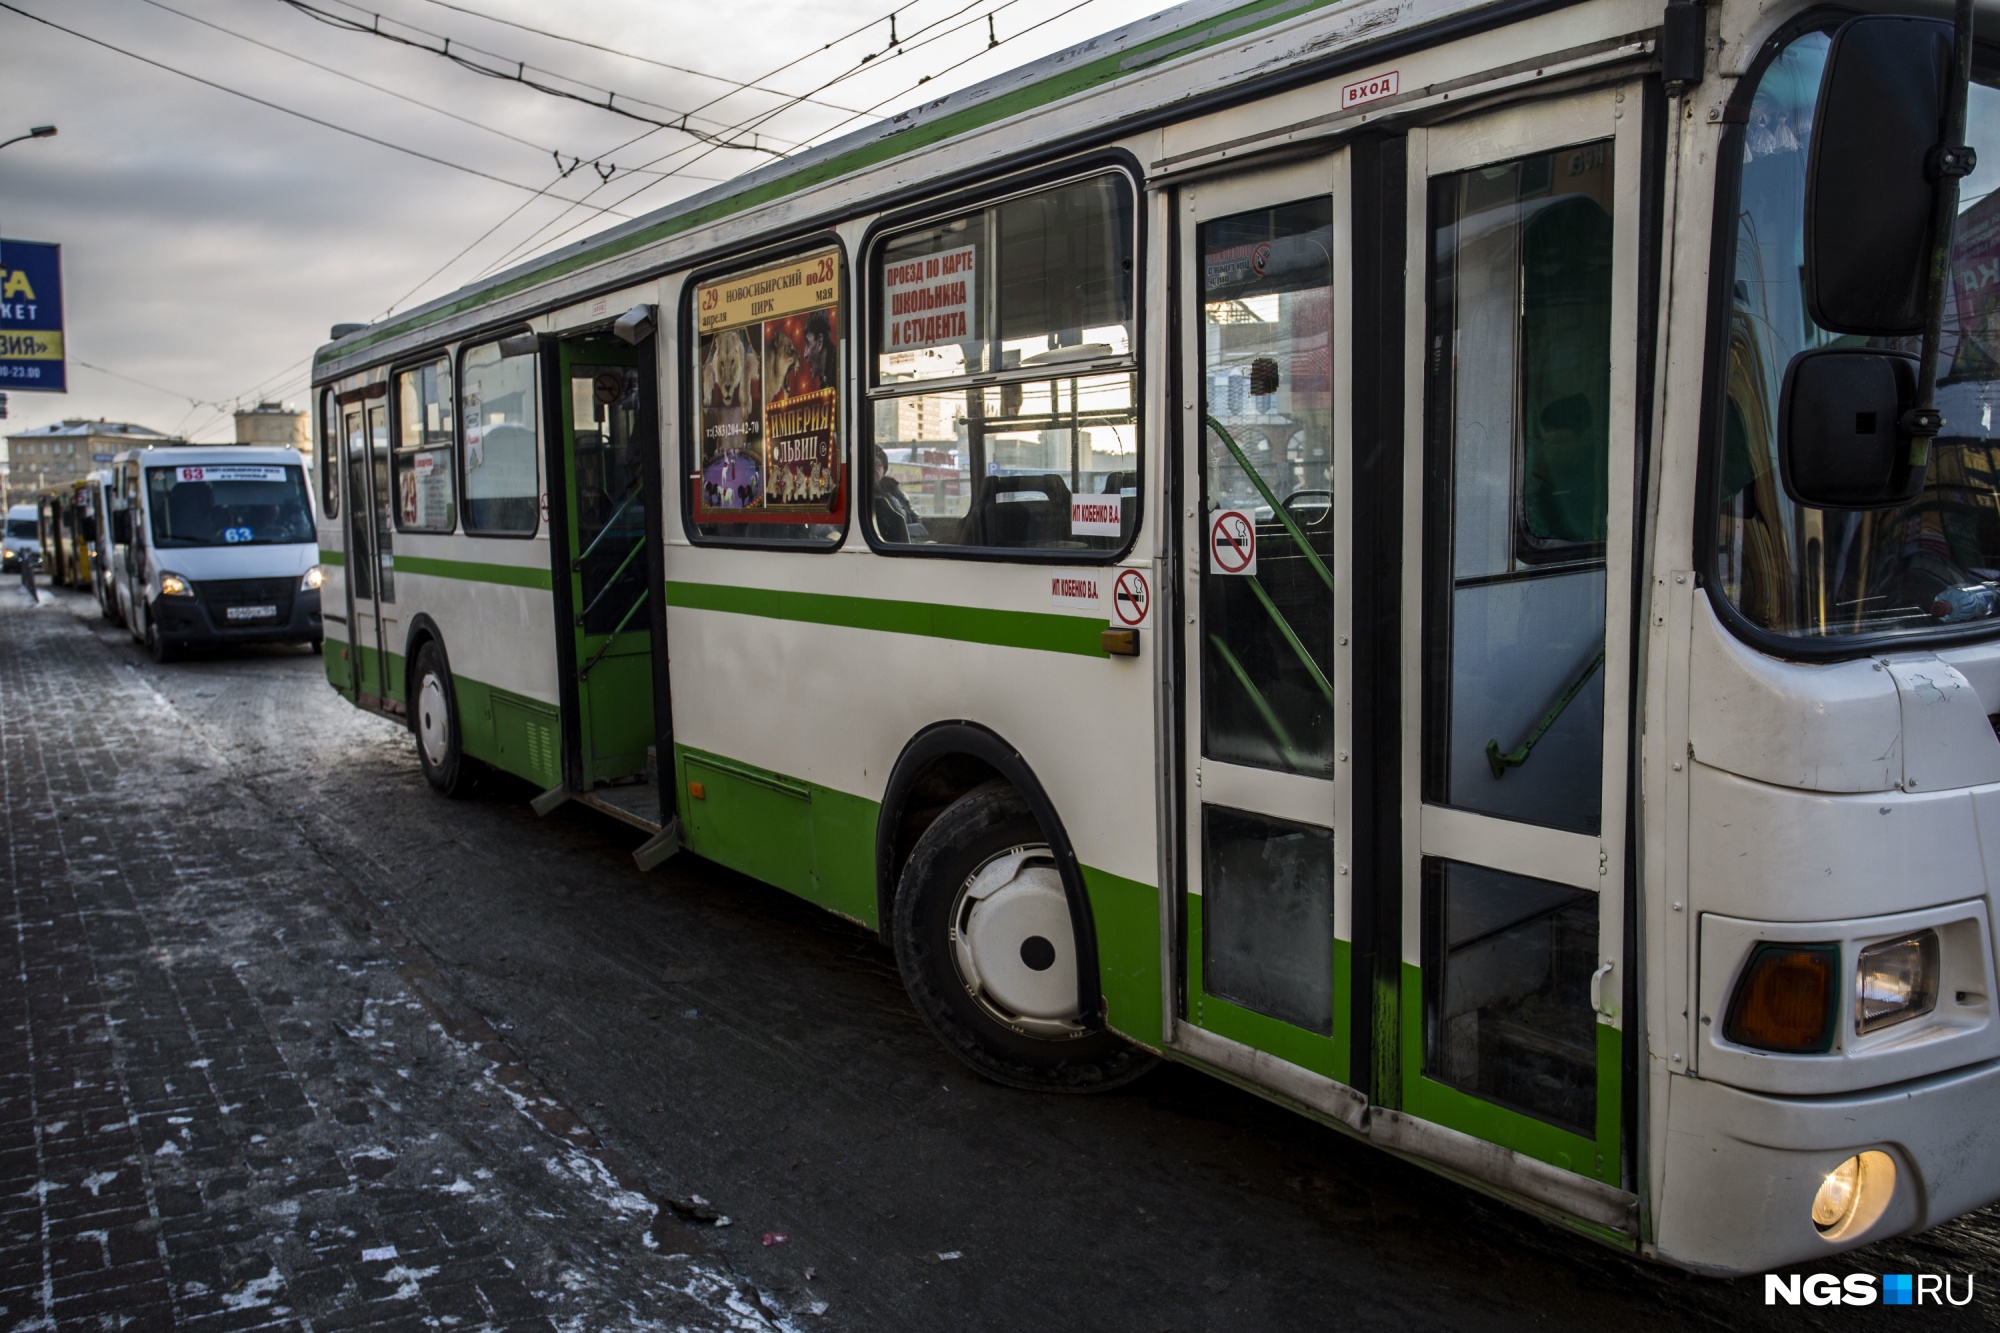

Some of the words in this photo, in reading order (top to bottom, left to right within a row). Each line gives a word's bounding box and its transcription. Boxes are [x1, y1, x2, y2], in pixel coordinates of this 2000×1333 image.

[1349, 79, 1390, 101] ВХОД
[887, 261, 924, 287] ПРОЕЗД
[926, 258, 939, 279] ПО
[942, 250, 973, 275] КАРТЕ
[726, 270, 802, 303] НОВОСИБИРСКИЙ
[815, 288, 833, 302] мая
[751, 298, 774, 316] ЦИРК
[892, 280, 967, 316] ШКОЛЬНИКА
[702, 312, 727, 328] апреля
[892, 322, 900, 346] И
[903, 311, 967, 345] СТУДЕНТА
[770, 401, 830, 439] ИМПЕРИЯ
[780, 435, 819, 464] ЛЬВИЦ
[1072, 504, 1081, 522] ИП
[1081, 504, 1108, 523] КОБЕНКО
[1108, 505, 1120, 523] В.А.
[225, 528, 252, 543] 63
[1052, 578, 1060, 596] ИП
[1061, 579, 1087, 598] КОБЕНКО
[1087, 580, 1098, 599] В.А.
